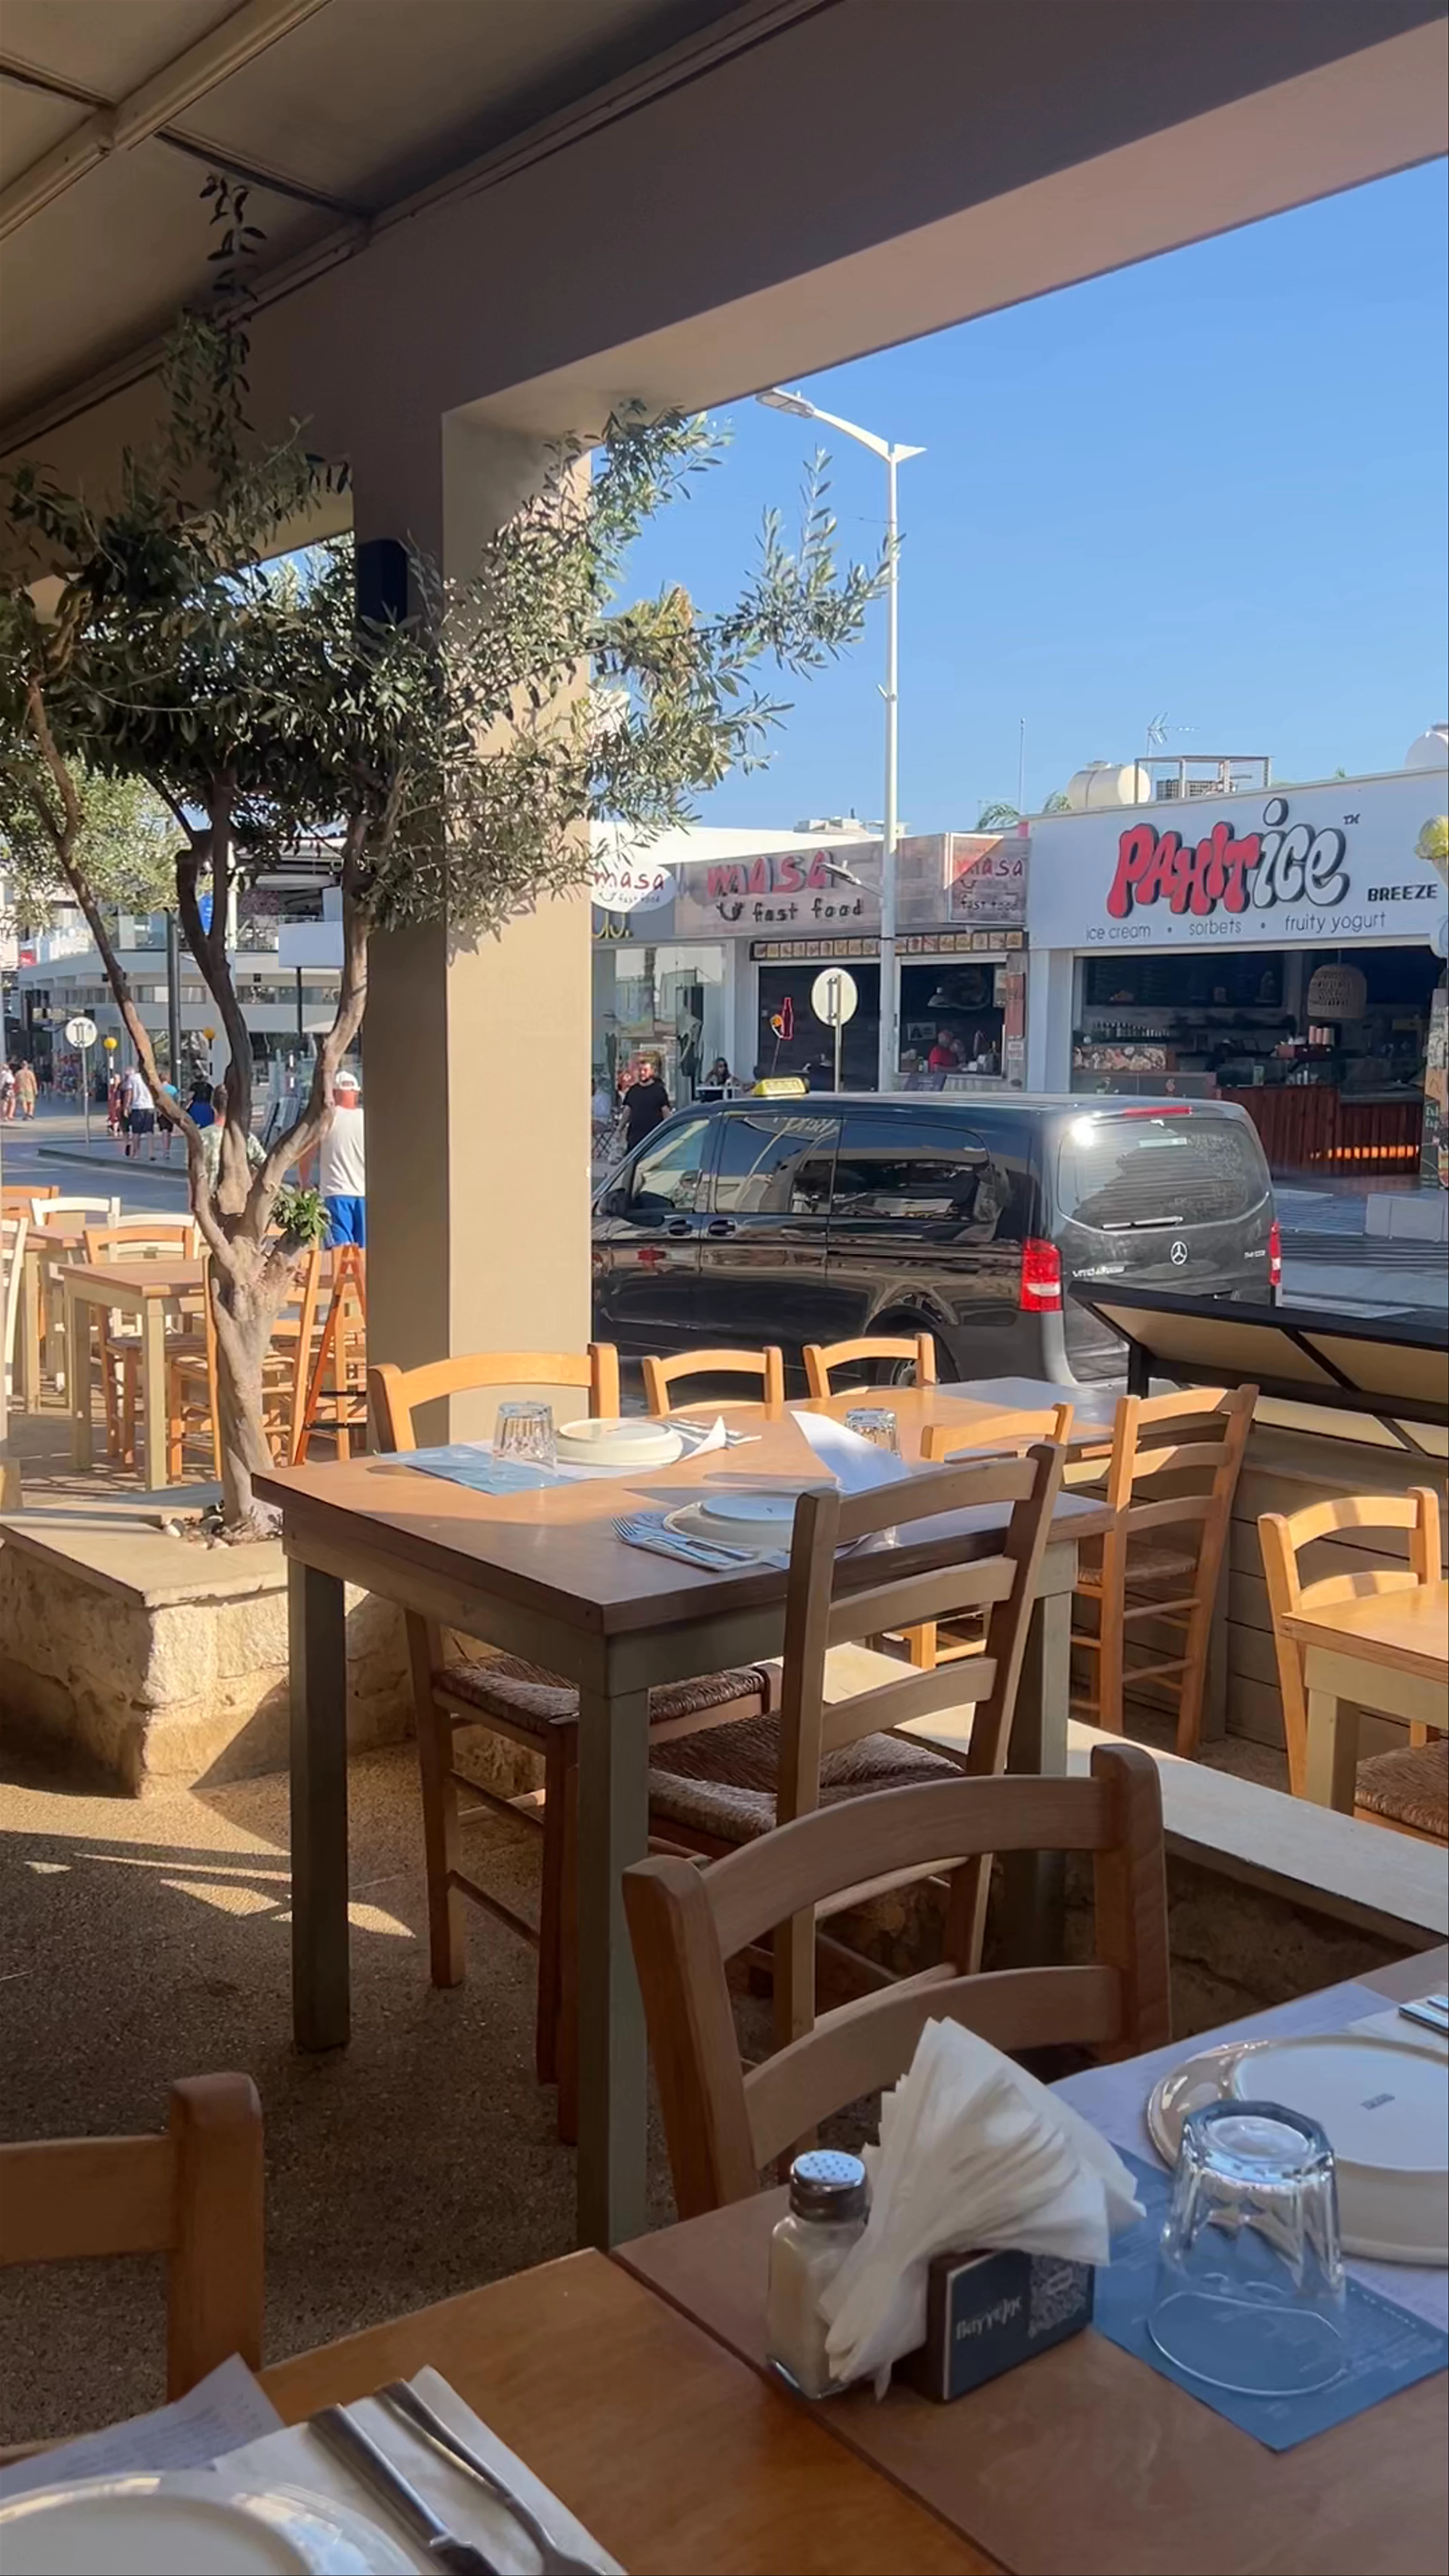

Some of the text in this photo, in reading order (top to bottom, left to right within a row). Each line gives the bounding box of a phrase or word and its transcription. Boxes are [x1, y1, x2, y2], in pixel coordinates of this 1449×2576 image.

[1367, 884, 1438, 901] BREEZE
[752, 897, 864, 922] fast food
[1086, 911, 1386, 940] ice cream sorbets fruity yogurt
